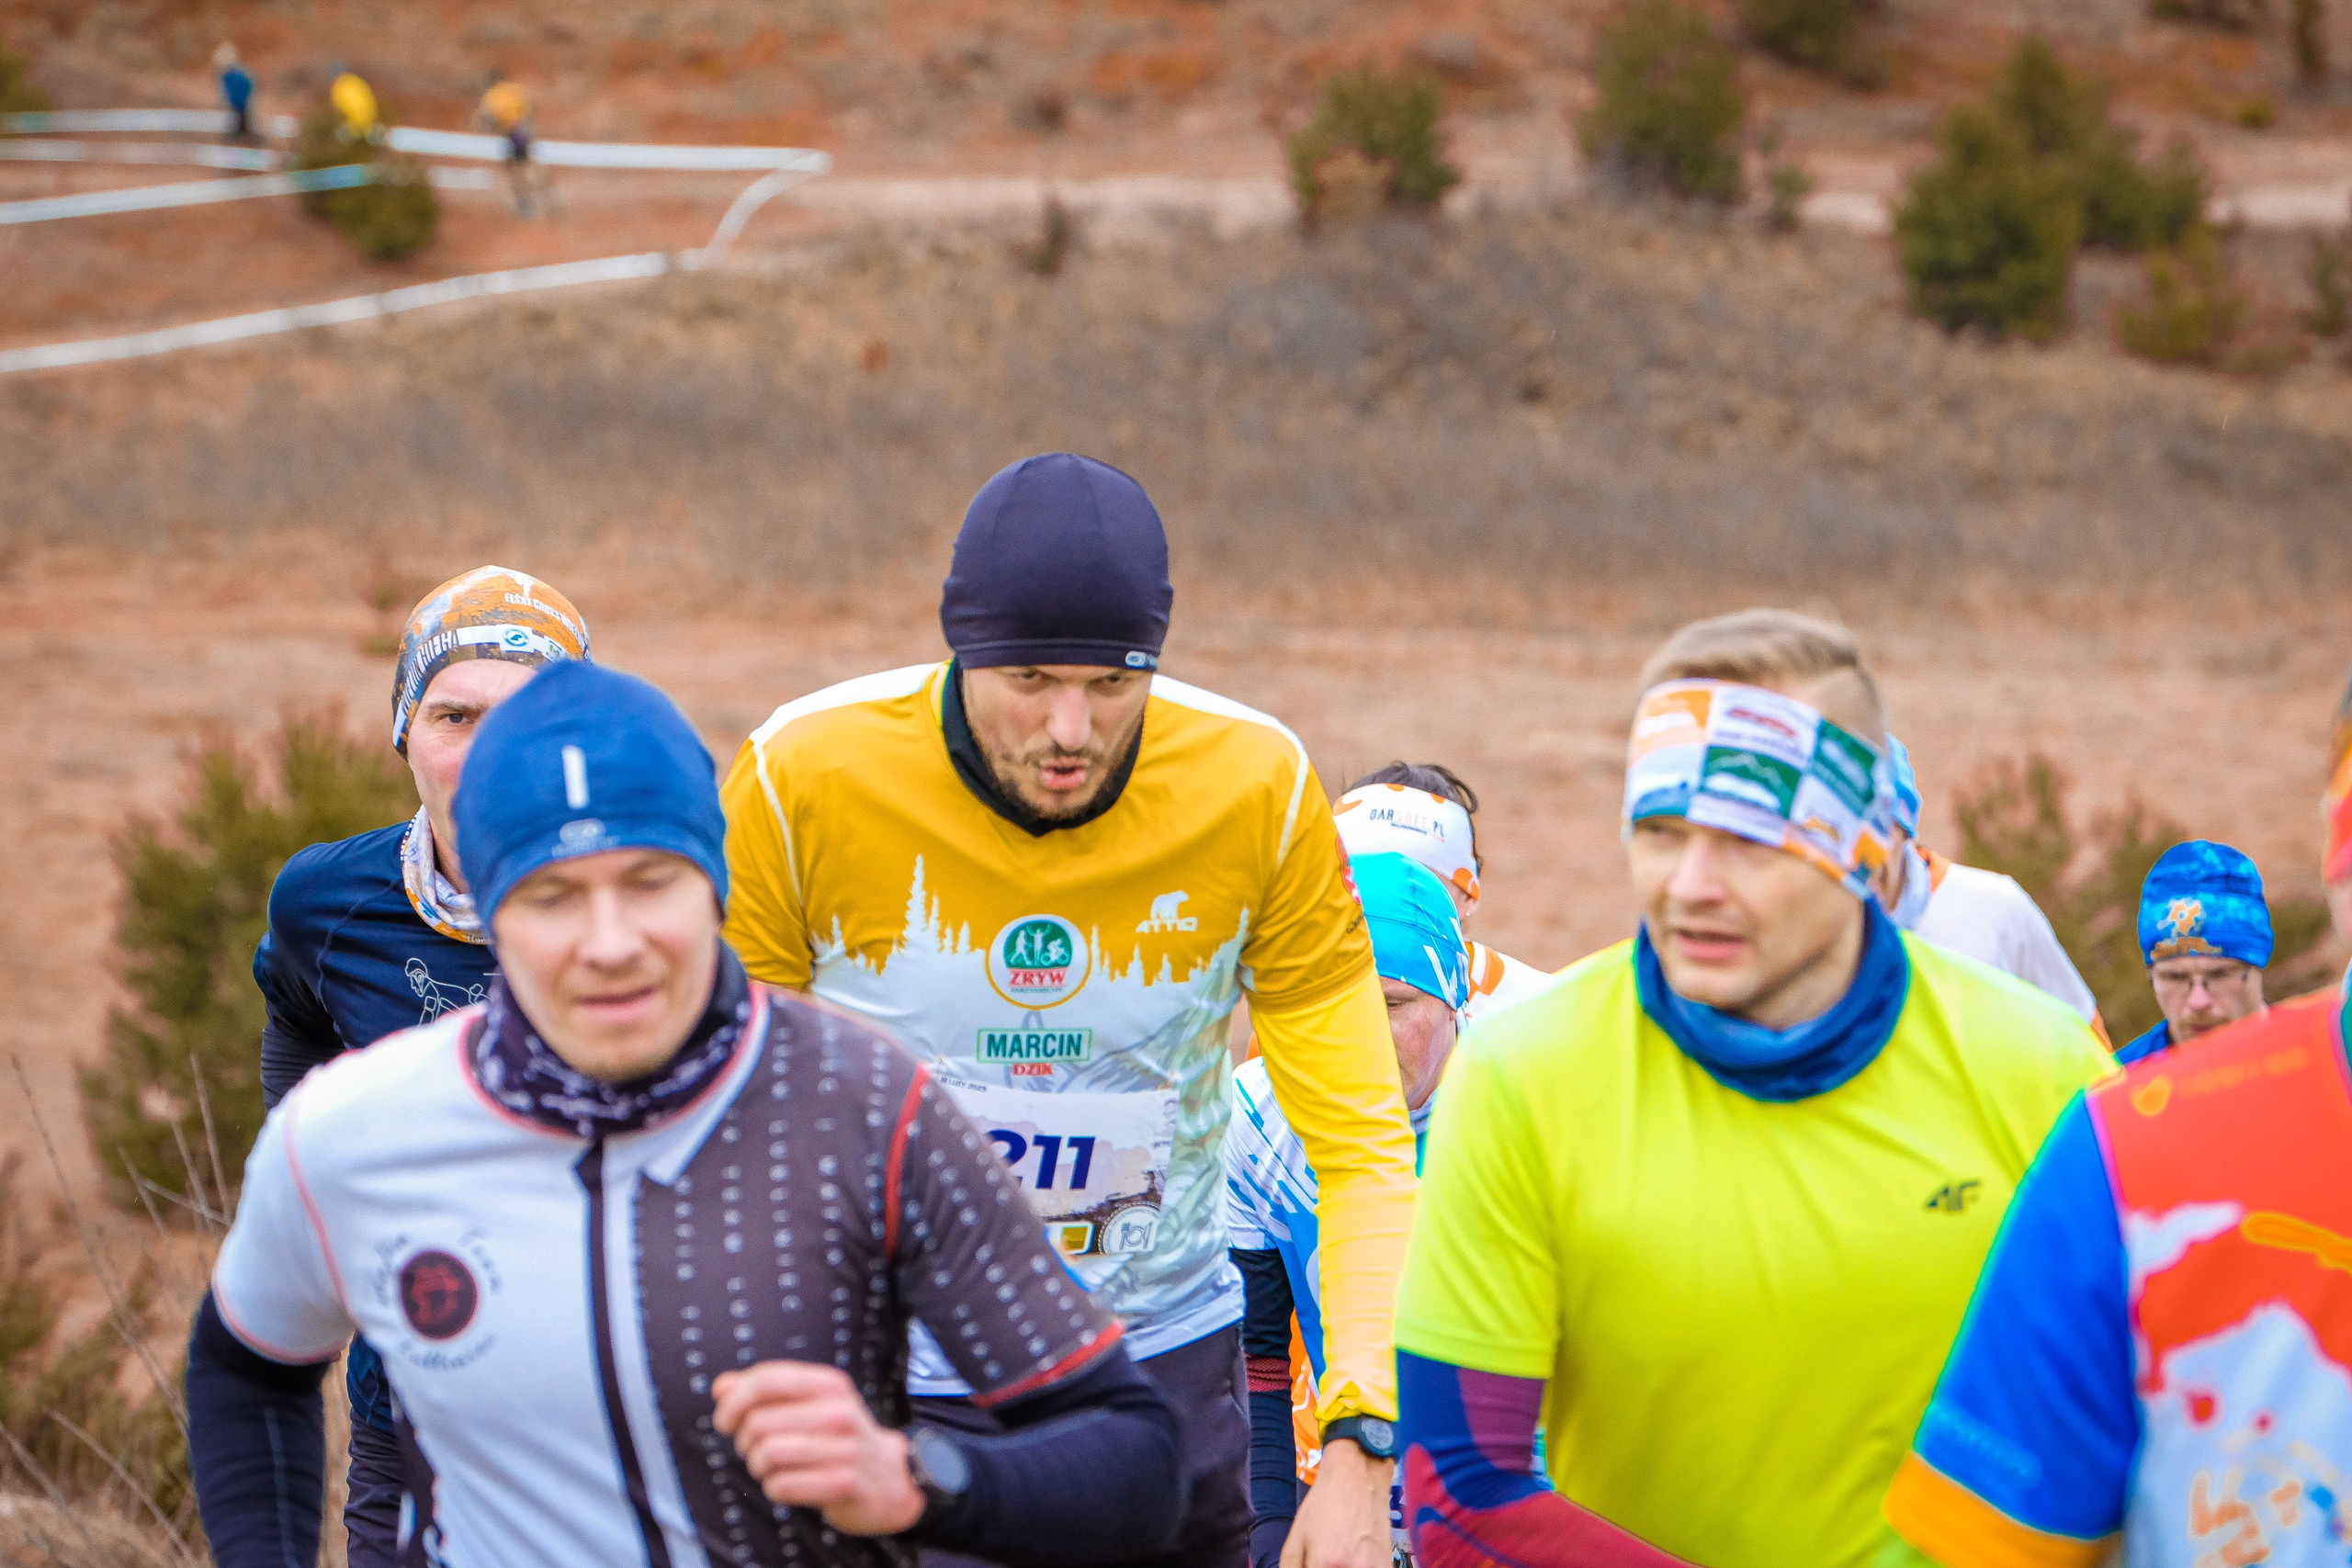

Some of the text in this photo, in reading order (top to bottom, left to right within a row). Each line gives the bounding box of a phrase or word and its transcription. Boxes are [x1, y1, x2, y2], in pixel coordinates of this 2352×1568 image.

[1009, 970, 1066, 986] ZRYW
[986, 1033, 1082, 1059] MARCIN
[1012, 1063, 1054, 1076] DZIK
